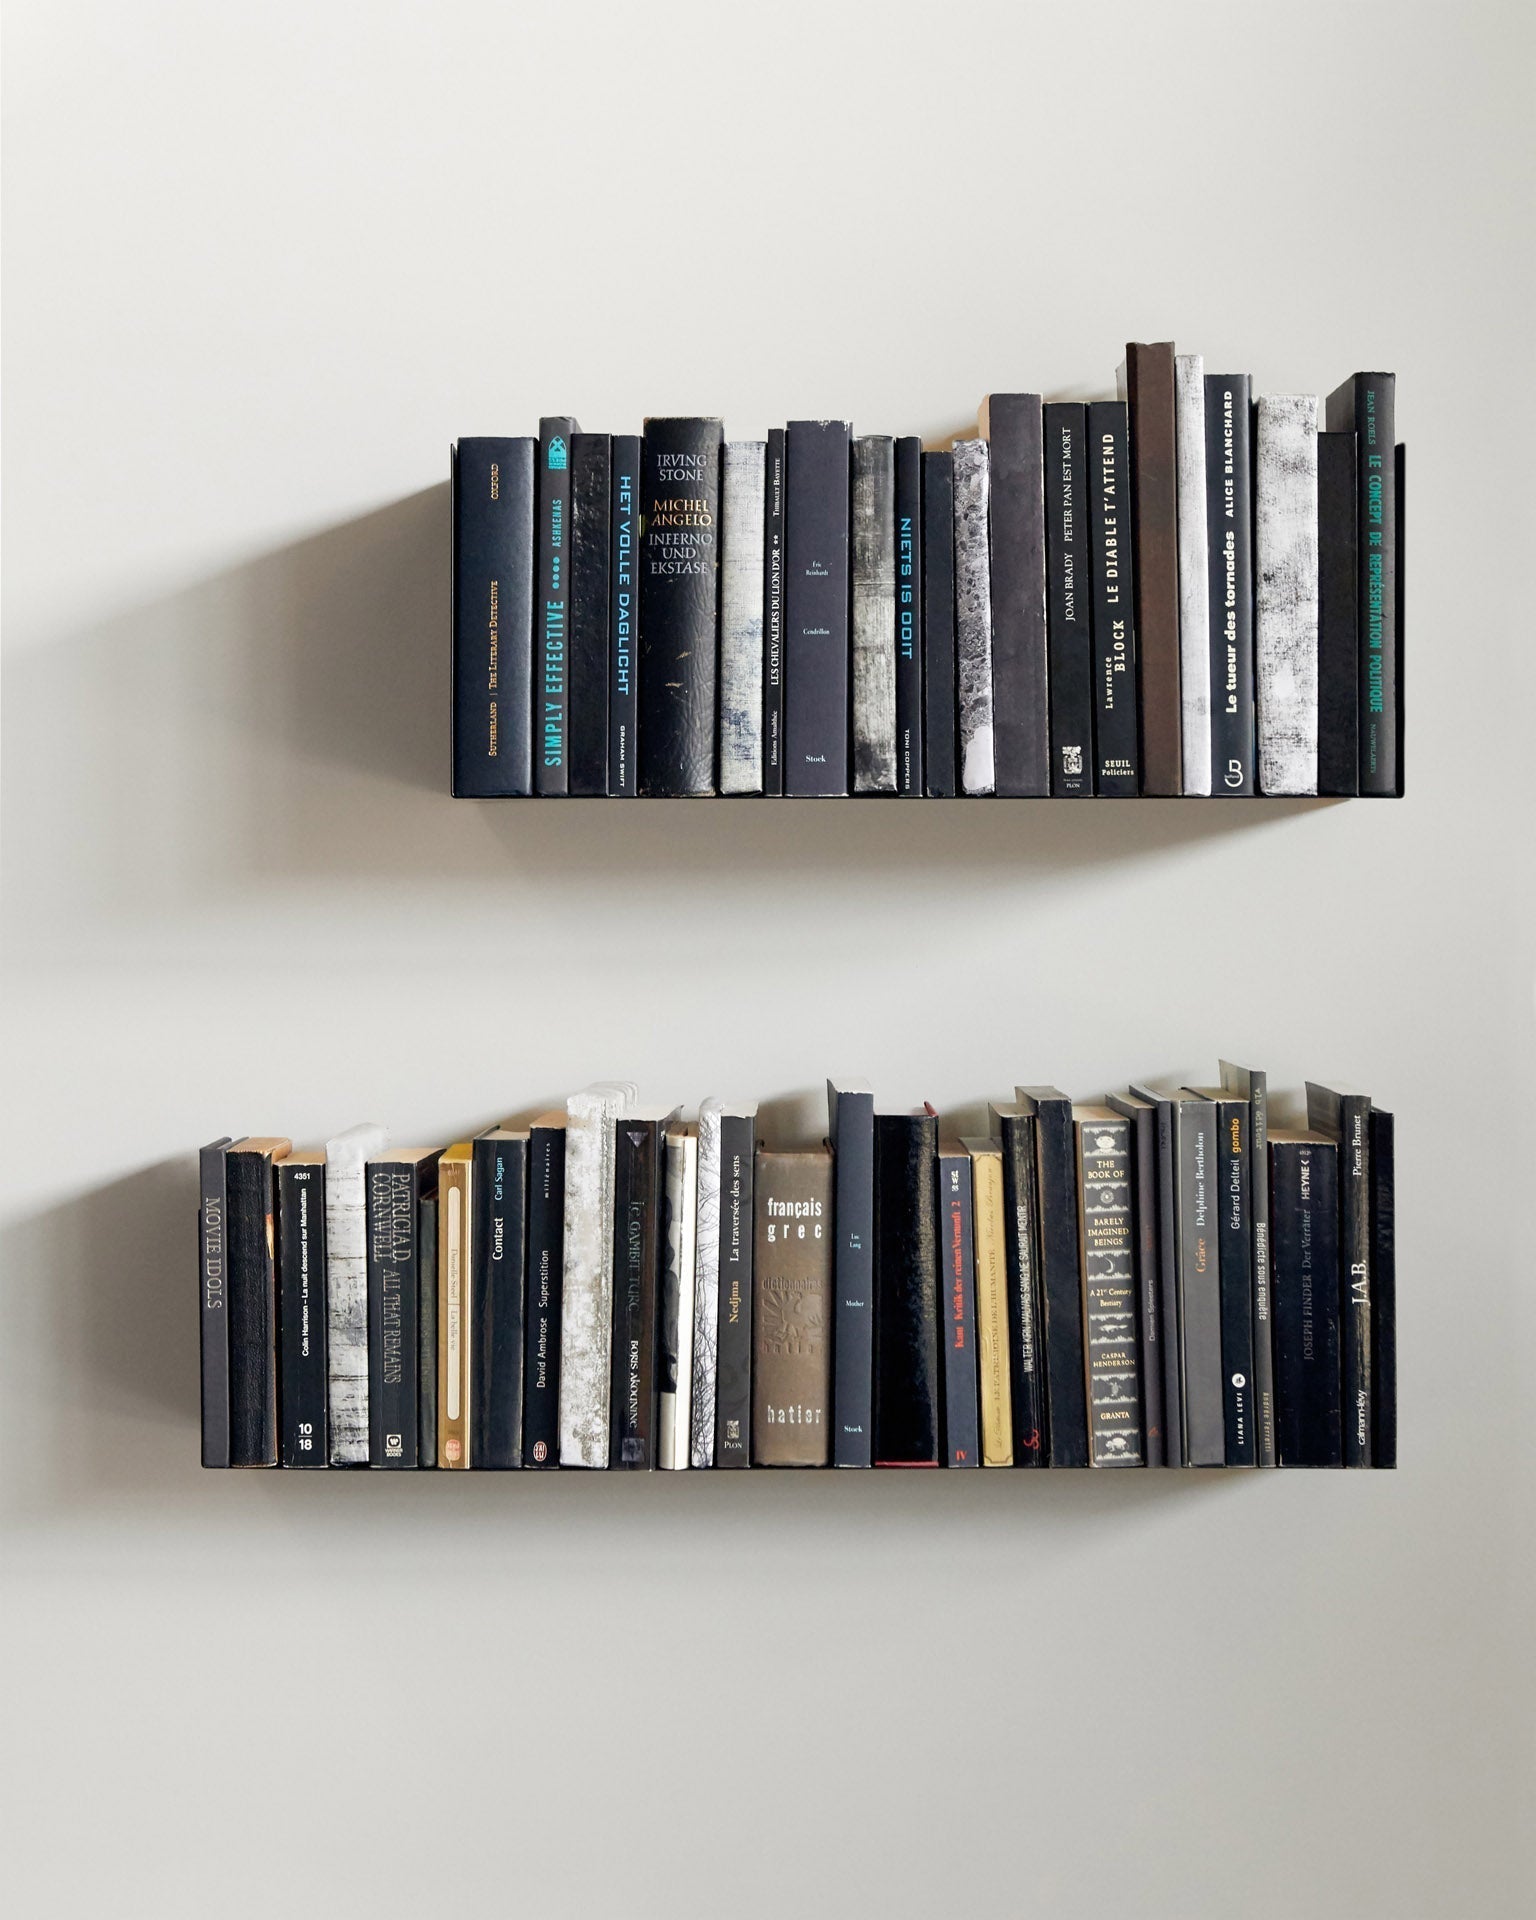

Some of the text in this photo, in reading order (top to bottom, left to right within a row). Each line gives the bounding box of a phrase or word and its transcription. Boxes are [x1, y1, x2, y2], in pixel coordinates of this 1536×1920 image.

[1367, 390, 1375, 413] JEAN
[657, 454, 707, 468] IRVING
[1224, 391, 1234, 518] ALICE BLANCHARD
[491, 464, 499, 500] OXFORD
[660, 469, 703, 481] STONE
[1062, 427, 1072, 541] PETER PAN EST MORT
[654, 500, 708, 512] MICHEL
[1102, 434, 1118, 603] LE DIABLE T'ATTEND
[552, 499, 562, 548] ASHKENAS
[652, 514, 712, 527] ANGELO
[649, 533, 712, 545] INFERNO
[662, 547, 696, 559] UND
[901, 518, 912, 576] NIETS
[651, 561, 708, 575] EKSTASE
[772, 549, 780, 570] D'OR
[618, 476, 631, 695] HET VOLLE DAGLICHT
[772, 572, 780, 594] LION
[901, 585, 912, 603] IS
[1064, 553, 1075, 621] JOAN BRADY
[1369, 455, 1384, 712] LE CONCEPT DE REPRÉSENTATION POLITIQUE
[772, 596, 779, 609] DU
[1223, 531, 1237, 713] Le tueur des tornades
[771, 611, 779, 666] CHEVALIERS
[1113, 620, 1125, 672] BLOCK
[545, 601, 563, 766] SIMPLY EFFECTIVE
[1105, 657, 1113, 709] Lawrence
[806, 755, 826, 763] Stock
[1231, 1118, 1241, 1153] gombo
[1352, 1115, 1362, 1176] Pierre Brunet
[495, 1157, 504, 1200] Carl Sagan
[1088, 1171, 1110, 1179] BOOK
[1195, 1133, 1207, 1226] Delphine Bertholon
[730, 1180, 739, 1200] des
[1231, 1159, 1240, 1230] Gérard Delteil
[372, 1173, 392, 1262] CORNWELL
[392, 1173, 411, 1247] PATRICIA
[767, 1197, 822, 1219] français
[1017, 1205, 1027, 1231] MENTIR
[731, 1202, 740, 1246] traversée
[952, 1212, 961, 1248] Vernunft
[1088, 1228, 1129, 1236] IMAGINED
[493, 1217, 503, 1260] Contact
[1018, 1232, 1029, 1260] SAURAIT
[1094, 1238, 1123, 1246] BEINGS
[1256, 1222, 1266, 1263] Bénédicte
[1301, 1209, 1311, 1268] Der Verräter
[206, 1197, 222, 1309] MOVIE IDOLS
[730, 1252, 739, 1262] La
[953, 1249, 962, 1275] reinen
[1019, 1262, 1029, 1272] NE
[1196, 1238, 1206, 1272] Grâce
[302, 1288, 308, 1298] La
[539, 1250, 549, 1308] Superstition
[953, 1278, 963, 1292] der
[1020, 1273, 1030, 1292] SANG
[1109, 1288, 1132, 1296] Century
[1351, 1260, 1371, 1306] J.A.B.
[451, 1310, 457, 1319] La
[729, 1280, 741, 1323] Nedjma
[954, 1294, 963, 1320] Kritik
[1100, 1299, 1122, 1307] Bestiary
[1258, 1287, 1267, 1320] enquête
[383, 1269, 402, 1384] ALL THAT REMAINS
[1302, 1274, 1315, 1360] JOSEPH FINDER
[537, 1318, 548, 1388] David Ambrose
[630, 1340, 639, 1370] BORIS
[1023, 1345, 1033, 1372] WALTER
[768, 1405, 821, 1424] hatier
[1101, 1412, 1130, 1420] GRANTA
[299, 1424, 312, 1434] 10
[844, 1425, 862, 1433] Stock
[299, 1439, 312, 1450] 18
[956, 1450, 966, 1460] IV
